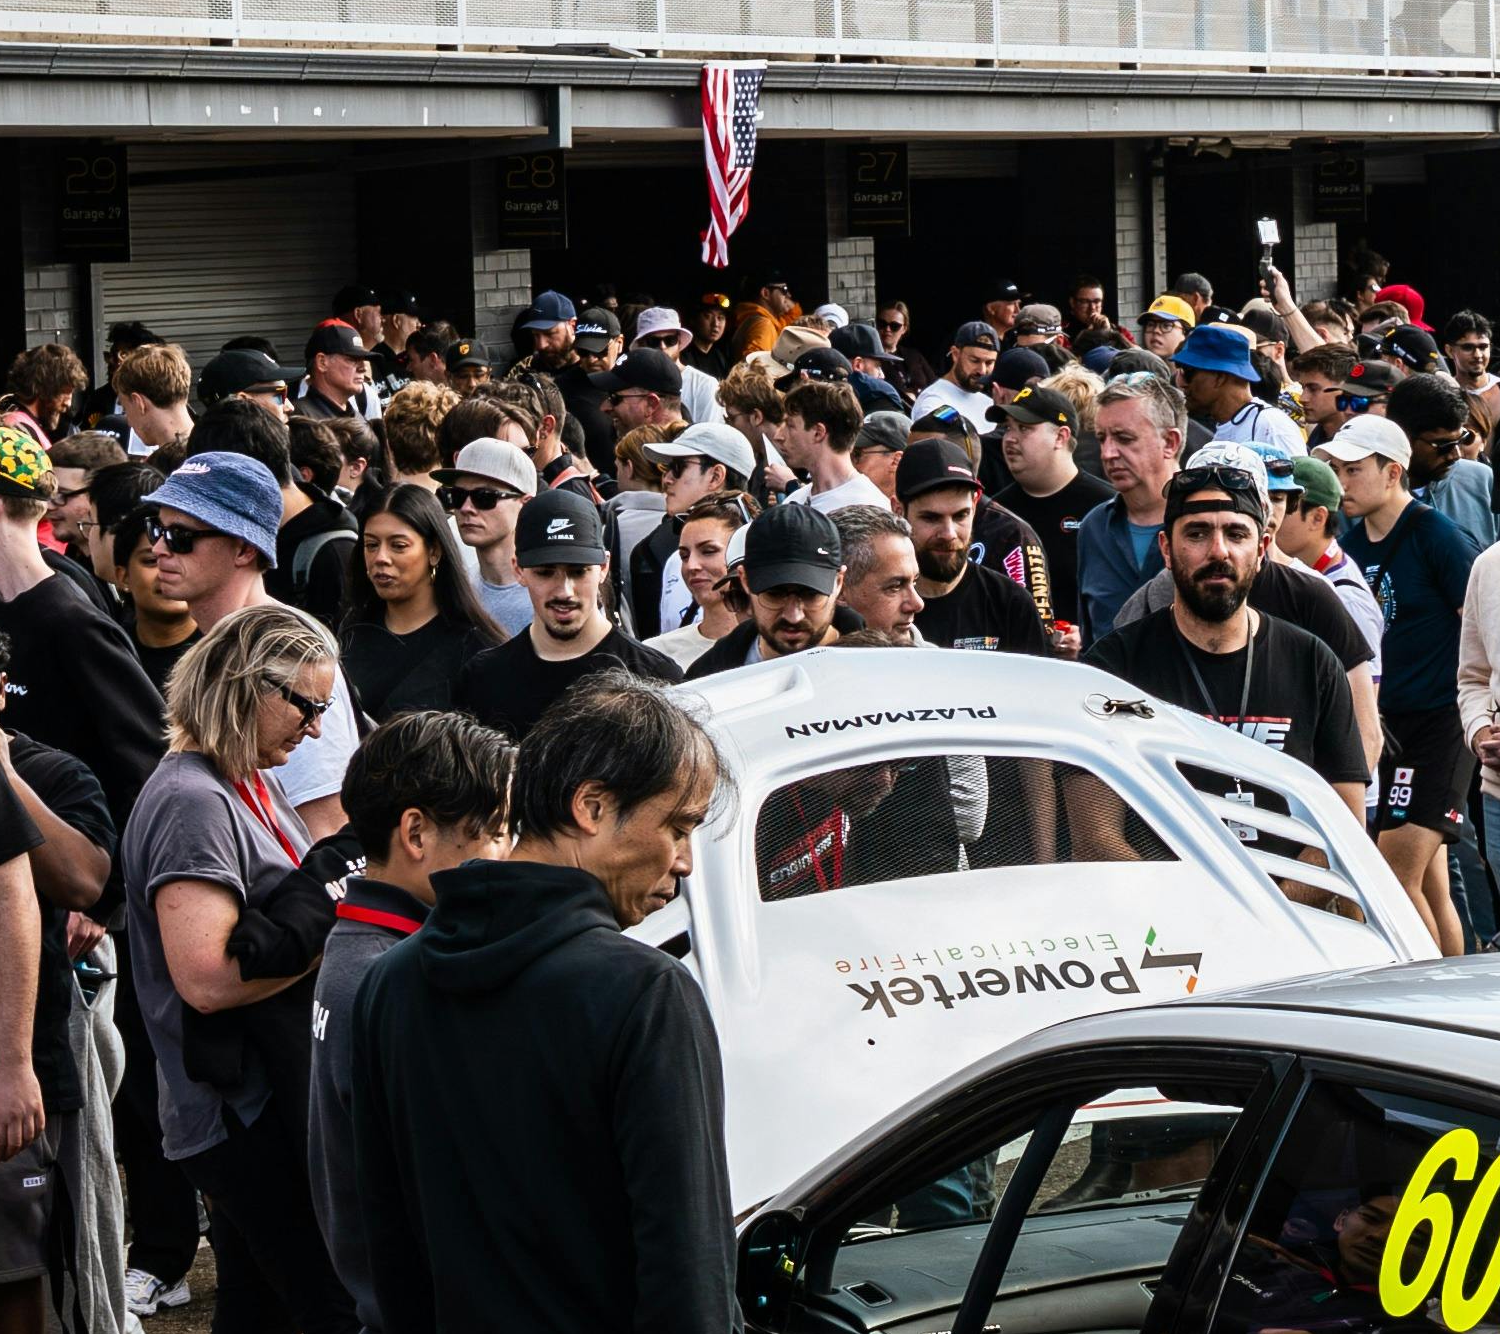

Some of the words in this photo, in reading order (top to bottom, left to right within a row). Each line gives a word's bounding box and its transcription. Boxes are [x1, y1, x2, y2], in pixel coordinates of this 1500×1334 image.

[66, 157, 117, 196] 29
[505, 156, 557, 190] 28
[857, 150, 897, 185] 27
[62, 207, 101, 223] Garage
[104, 206, 122, 221] 29
[504, 199, 541, 213] Garage
[853, 191, 889, 206] Garage
[891, 191, 904, 203] 27
[785, 704, 998, 740] PLAZMAMAN
[1388, 786, 1412, 807] 99
[848, 955, 1143, 1018] Powertek
